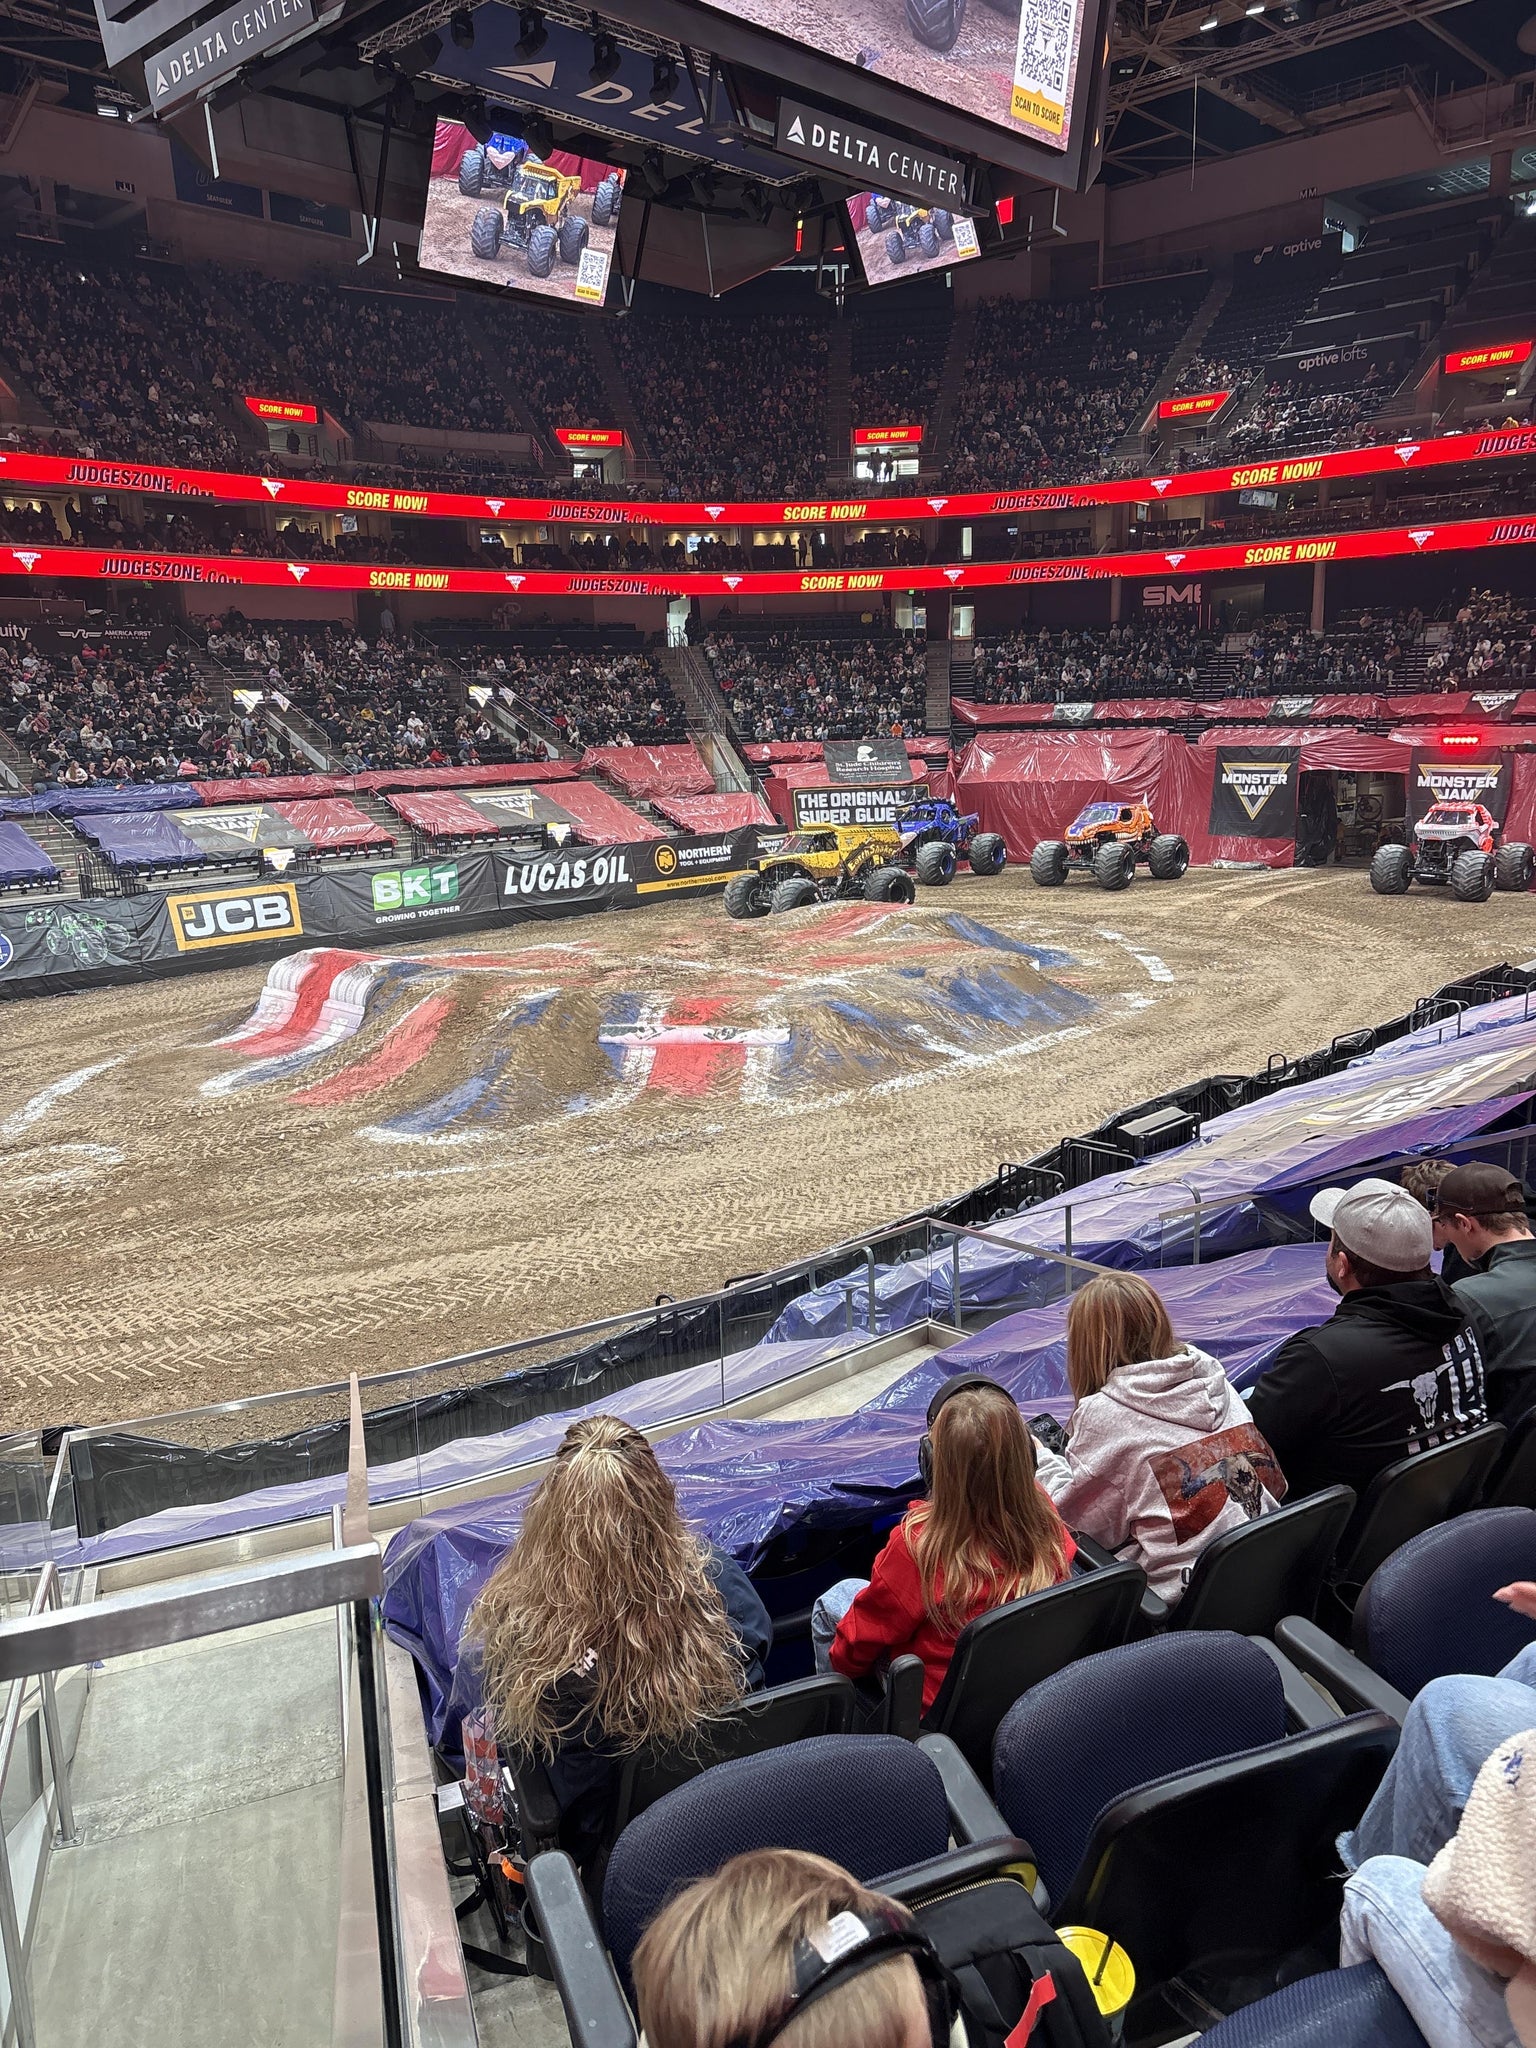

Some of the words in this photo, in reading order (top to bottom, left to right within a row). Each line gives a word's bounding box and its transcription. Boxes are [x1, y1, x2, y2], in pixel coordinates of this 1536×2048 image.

[169, 31, 228, 84] DELTA
[1014, 95, 1032, 113] SCAN
[1032, 102, 1041, 117] TO
[1040, 106, 1061, 125] SCORE
[811, 123, 880, 168] DELTA
[887, 151, 958, 195] CENTER
[1283, 238, 1322, 257] aptive
[1298, 353, 1339, 372] aptive
[1340, 345, 1368, 363] lofts
[1460, 353, 1489, 367] SCORE
[1489, 349, 1515, 361] NOW!
[259, 404, 283, 414] SCORE
[284, 407, 303, 417] NOW!
[1171, 402, 1194, 413] SCORE
[1195, 399, 1215, 408] NOW!
[567, 433, 590, 441] SCORE
[591, 434, 609, 442] NOW!
[867, 431, 888, 440] SCORE
[889, 431, 909, 439] NOW!
[346, 490, 390, 508] SCORE
[393, 494, 428, 511] NOW!
[783, 505, 827, 520] SCORE
[830, 504, 867, 519] NOW!
[1230, 466, 1277, 487] SCORE
[1281, 460, 1324, 481] NOW!
[369, 571, 412, 587] SCORE
[414, 573, 449, 588] NOW!
[800, 575, 844, 590] SCORE
[847, 574, 884, 589] NOW!
[1244, 545, 1293, 564] SCORE
[1295, 541, 1337, 560] NOW!
[1221, 773, 1288, 785] MONSTER
[1417, 775, 1498, 788] MONSTER
[1239, 784, 1269, 796] JAM
[1438, 788, 1475, 800] JAM
[797, 793, 828, 808] THE
[799, 808, 850, 824] SUPER
[855, 806, 897, 823] GLUE
[678, 845, 732, 860] NORTHERN
[699, 855, 732, 865] EQUIPMENT
[504, 859, 588, 895] LUCAS
[666, 875, 727, 888] www.northerntool.com
[374, 870, 456, 904] BKT
[184, 895, 291, 937] JCB
[375, 911, 416, 924] GROWING
[417, 905, 460, 918] TOGETHER
